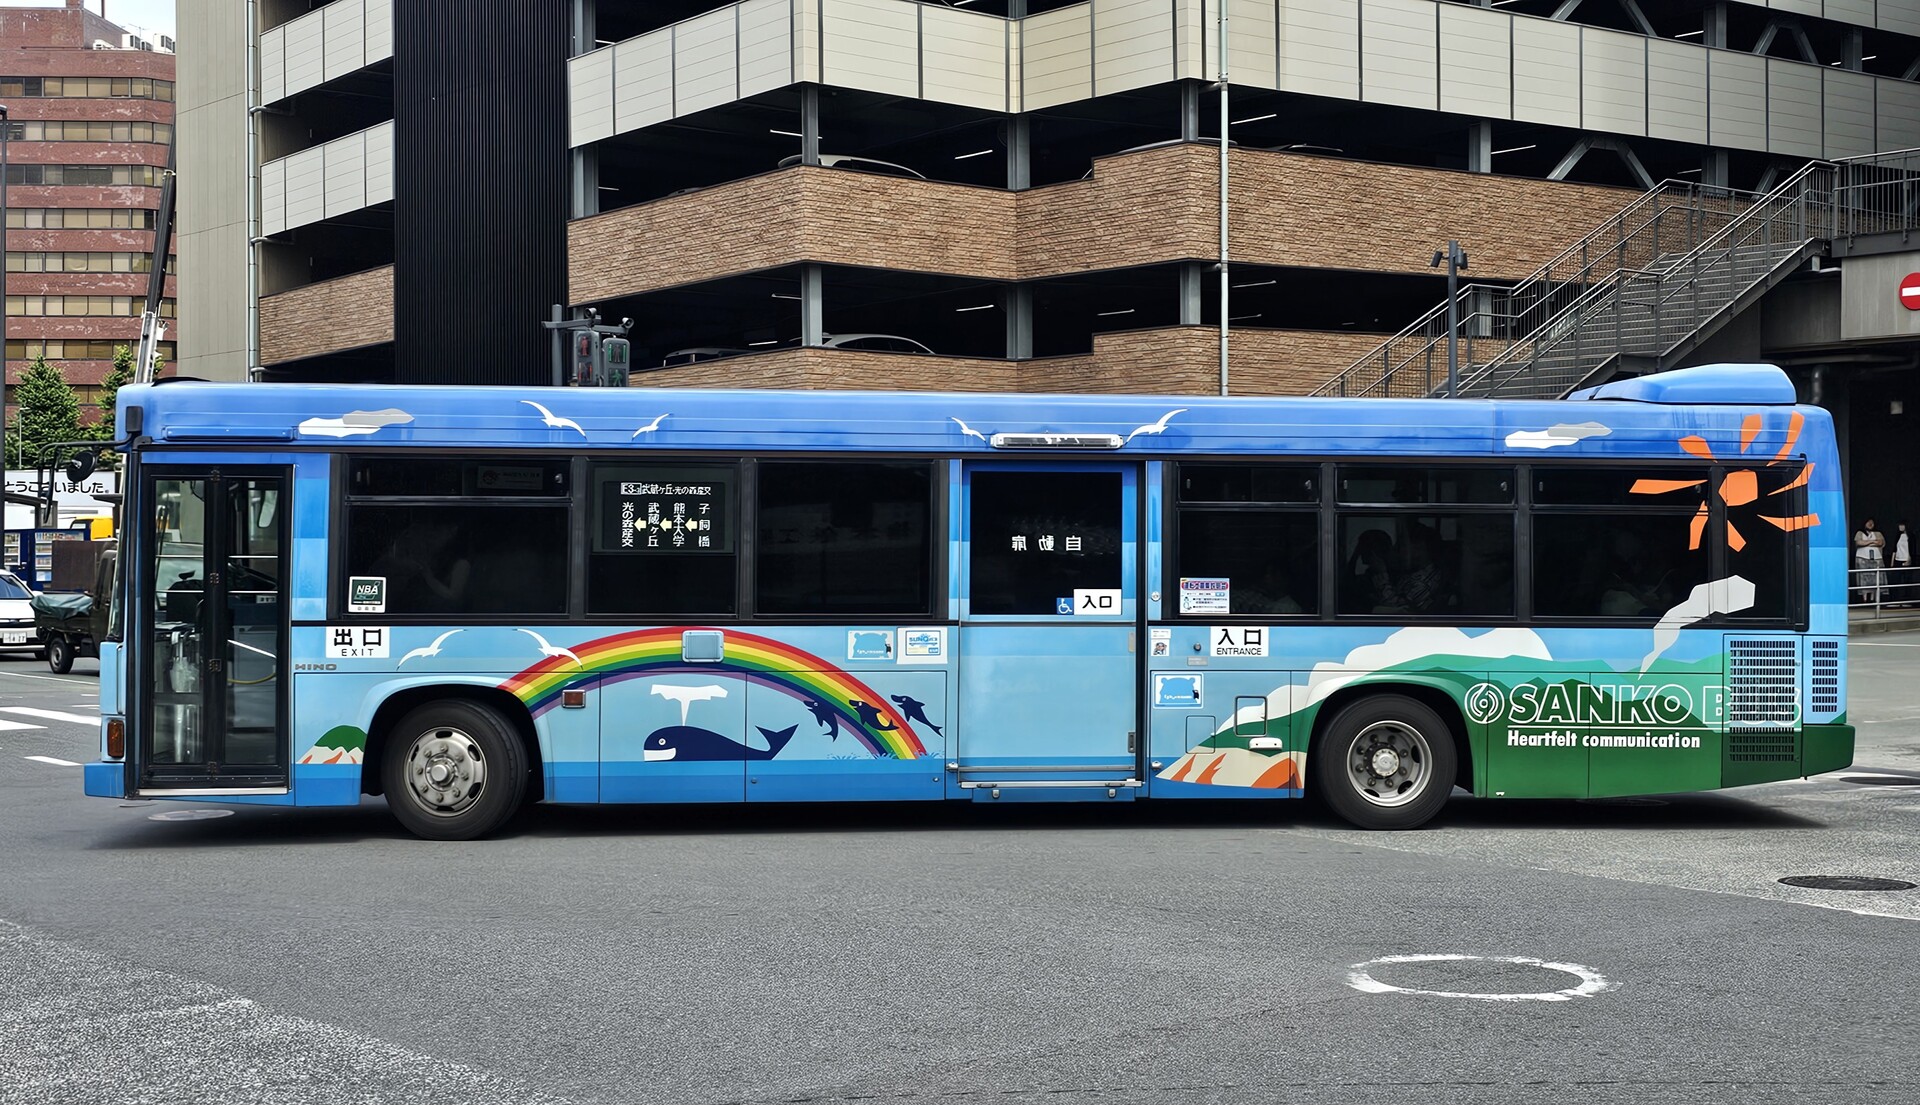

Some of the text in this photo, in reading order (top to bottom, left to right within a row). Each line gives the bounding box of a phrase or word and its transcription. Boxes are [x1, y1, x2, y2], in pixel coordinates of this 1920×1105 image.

[622, 502, 634, 547] 光の森産交
[673, 502, 685, 547] 熊本大学
[356, 585, 378, 595] NBA
[1082, 595, 1112, 609] 入口
[334, 628, 381, 646] 出口
[1218, 628, 1261, 646] 入口
[341, 648, 374, 657] EXIT
[1216, 647, 1262, 655] ENTRANCE
[295, 663, 337, 671] HINO
[1508, 684, 1802, 726] SANKO BS
[1507, 730, 1700, 748] Heartfelt communication
